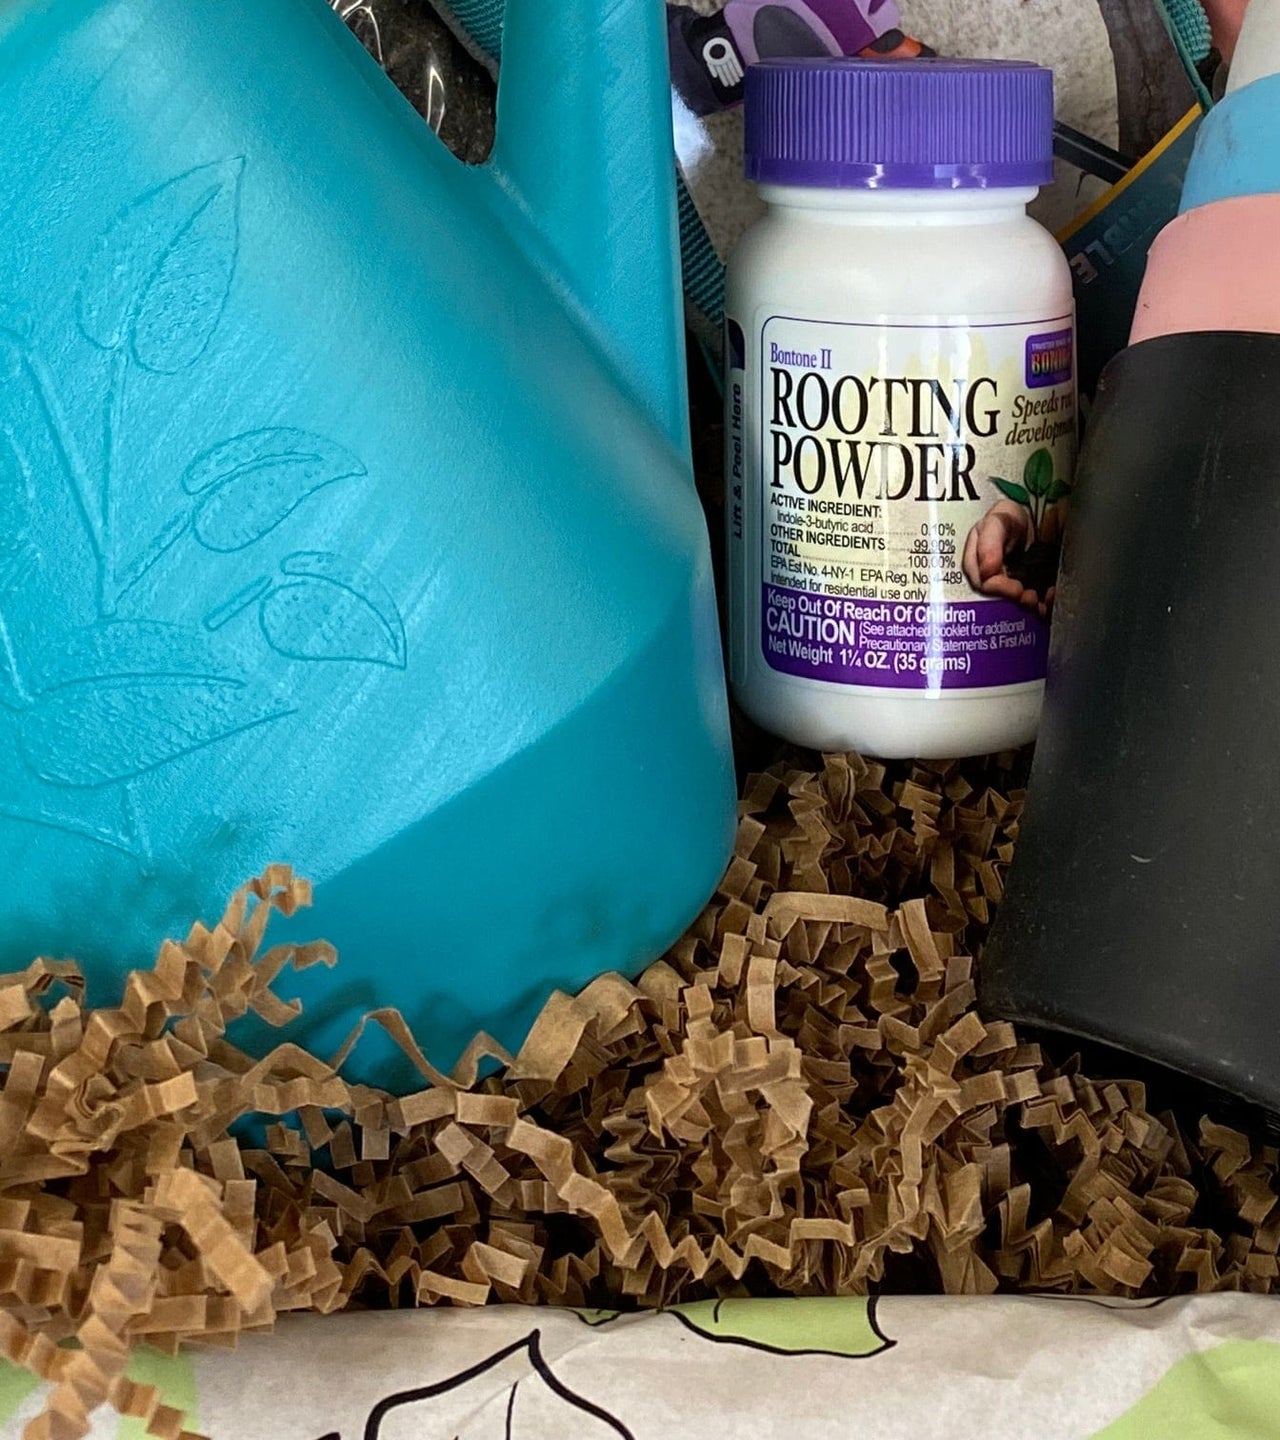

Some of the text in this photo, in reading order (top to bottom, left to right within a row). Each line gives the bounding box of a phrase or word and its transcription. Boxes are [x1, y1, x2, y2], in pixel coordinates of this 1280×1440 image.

[770, 342, 832, 369] Bontone II
[770, 367, 1000, 437] ROOTING
[1012, 390, 1058, 424] Speeds
[732, 383, 742, 540] Lift & Peel Here
[770, 429, 980, 502] POWDER
[771, 492, 881, 518] ACTIVE INGREDIENT:
[771, 523, 804, 542] OTHER
[806, 531, 885, 551] INGREDIENTS
[777, 510, 848, 533] Indole-3-butyric
[851, 521, 873, 534] acid
[771, 539, 801, 557] TOTAL
[771, 571, 926, 603] Intended for residential use only
[821, 565, 854, 580] 4-NY-1
[860, 568, 883, 582] EPA
[886, 570, 909, 587] Reg.
[768, 588, 796, 613] Keep
[798, 595, 821, 615] Out
[824, 600, 841, 617] Of
[843, 602, 890, 622] Reach
[894, 605, 913, 622] Of
[767, 607, 1026, 646] CAUTION (See attached booklet for additional
[768, 634, 787, 655] Net
[788, 639, 833, 665] Weight
[864, 650, 891, 669] OZ.
[894, 653, 917, 674] (35
[920, 653, 971, 674] grams)
[859, 636, 929, 655] Precautionary
[932, 637, 988, 652] Statements
[990, 636, 998, 650] &
